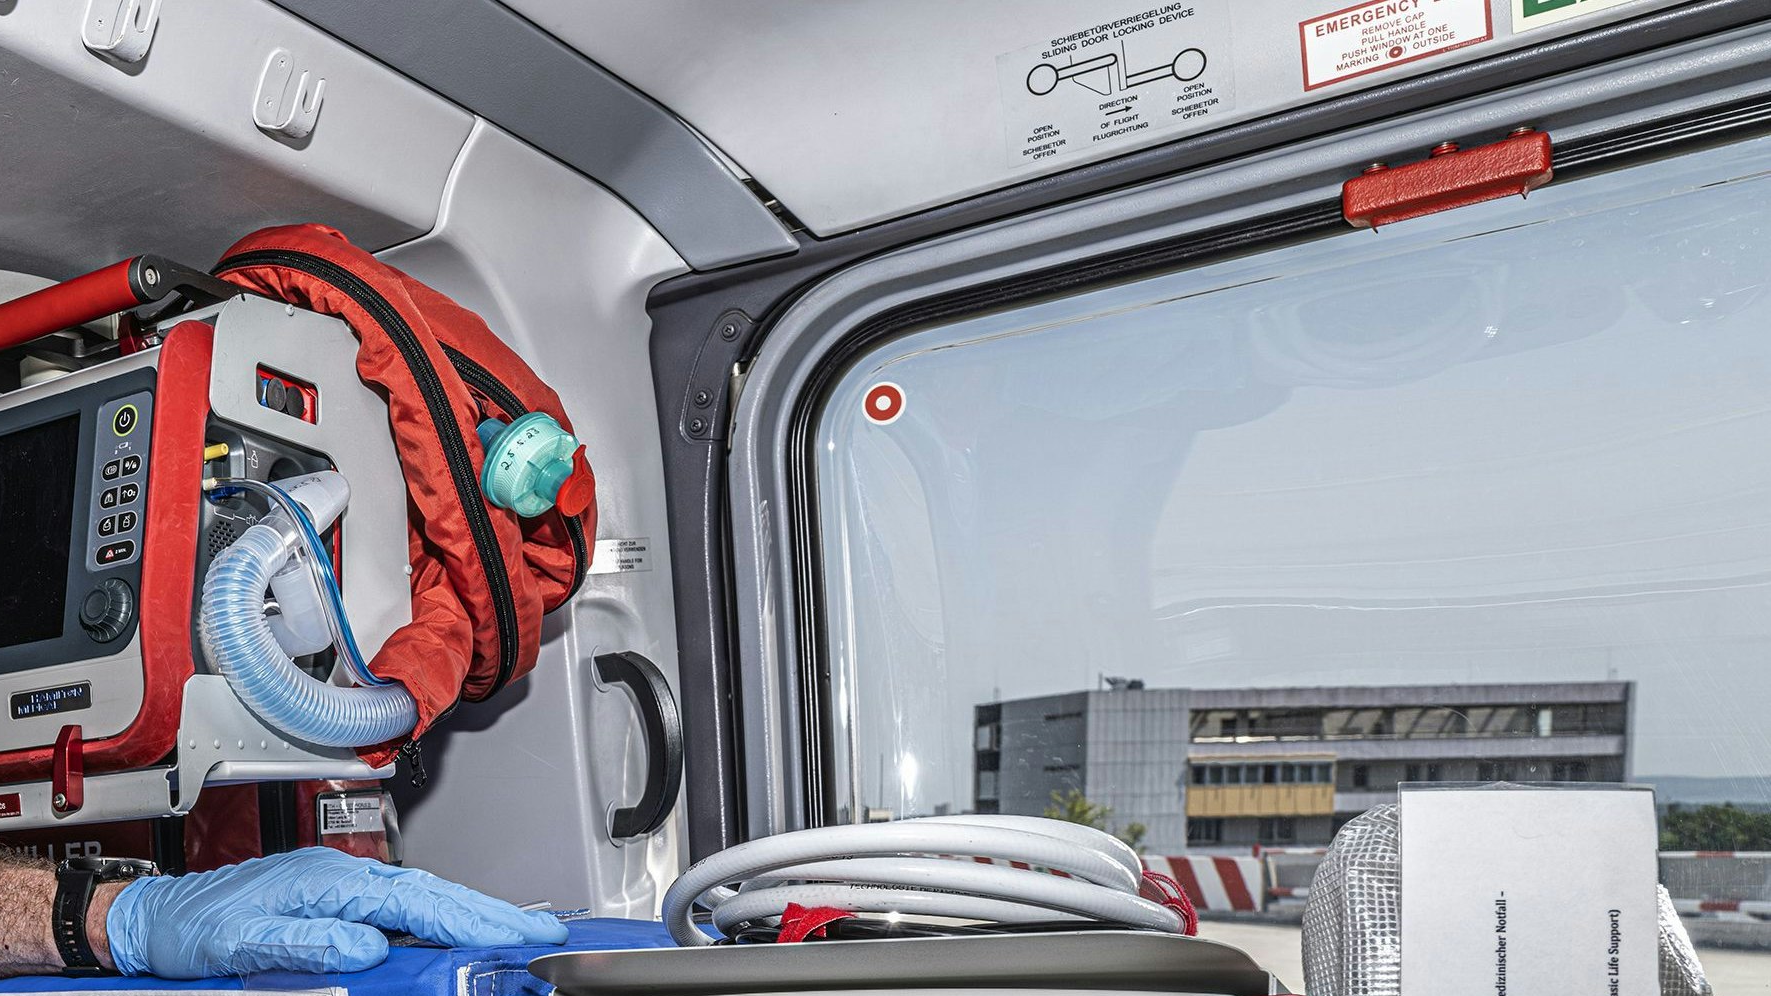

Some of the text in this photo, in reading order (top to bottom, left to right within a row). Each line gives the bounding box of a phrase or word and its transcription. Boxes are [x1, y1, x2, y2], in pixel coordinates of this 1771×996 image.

[1051, 2, 1182, 48] SCHIEBETÜRVERRIEGELUNG
[1315, 0, 1420, 38] EMERGENCY
[1361, 11, 1425, 37] REMOVE CAP
[1041, 7, 1195, 60] SLIDING DOOR LOCKING DEVICE
[1341, 23, 1449, 61] PUSH WINDOW AT ONE
[1361, 20, 1427, 46] PULL HANDLE
[1336, 53, 1380, 72] MARKING
[1412, 31, 1456, 50] OUTSIDE
[1176, 88, 1213, 102] POSITION
[1183, 82, 1205, 93] OPEN
[1098, 95, 1138, 111] DIRECTION
[1171, 98, 1219, 116] SCHIEBETÜR
[1100, 114, 1139, 130] OF FLIGHT
[1182, 108, 1208, 120] OFFEN
[1027, 129, 1060, 143] POSITION
[1033, 124, 1053, 135] OPEN
[1092, 121, 1149, 142] FLUGRICHTUNG
[1022, 139, 1066, 157] SCHIEBETÜR
[1033, 149, 1057, 161] OFFEN
[1495, 899, 1506, 933] Notfall
[1608, 909, 1621, 955] Support)
[1608, 957, 1619, 977] Life
